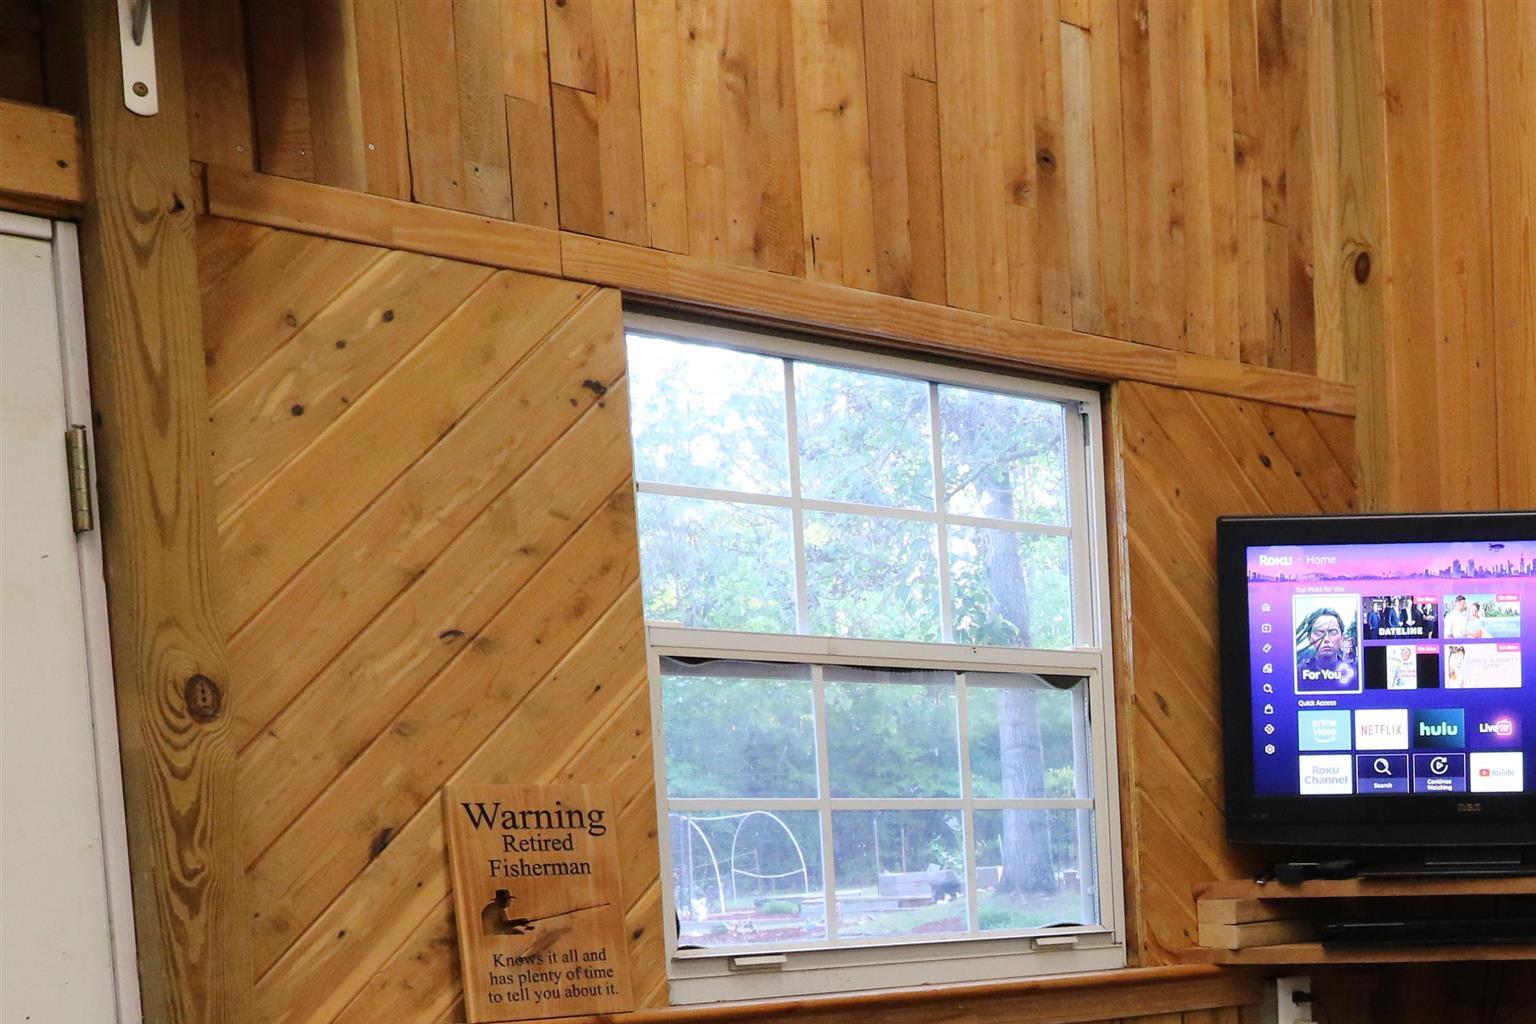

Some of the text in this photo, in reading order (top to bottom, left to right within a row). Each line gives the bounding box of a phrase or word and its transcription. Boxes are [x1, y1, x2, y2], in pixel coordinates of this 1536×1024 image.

[1306, 555, 1336, 564] Home
[1378, 627, 1423, 636] DATELINE
[1302, 669, 1341, 680] For You
[1361, 724, 1402, 737] NETFLIX
[1419, 722, 1458, 736] hulu
[1479, 723, 1498, 733] Live
[1304, 775, 1348, 785] Channel
[461, 801, 606, 836] Warning
[502, 834, 574, 852] Retired
[488, 859, 591, 877] Fisherman
[493, 948, 607, 968] Knows it all and
[490, 966, 614, 987] has plenty of time
[488, 983, 618, 1003] to tell you about it.
